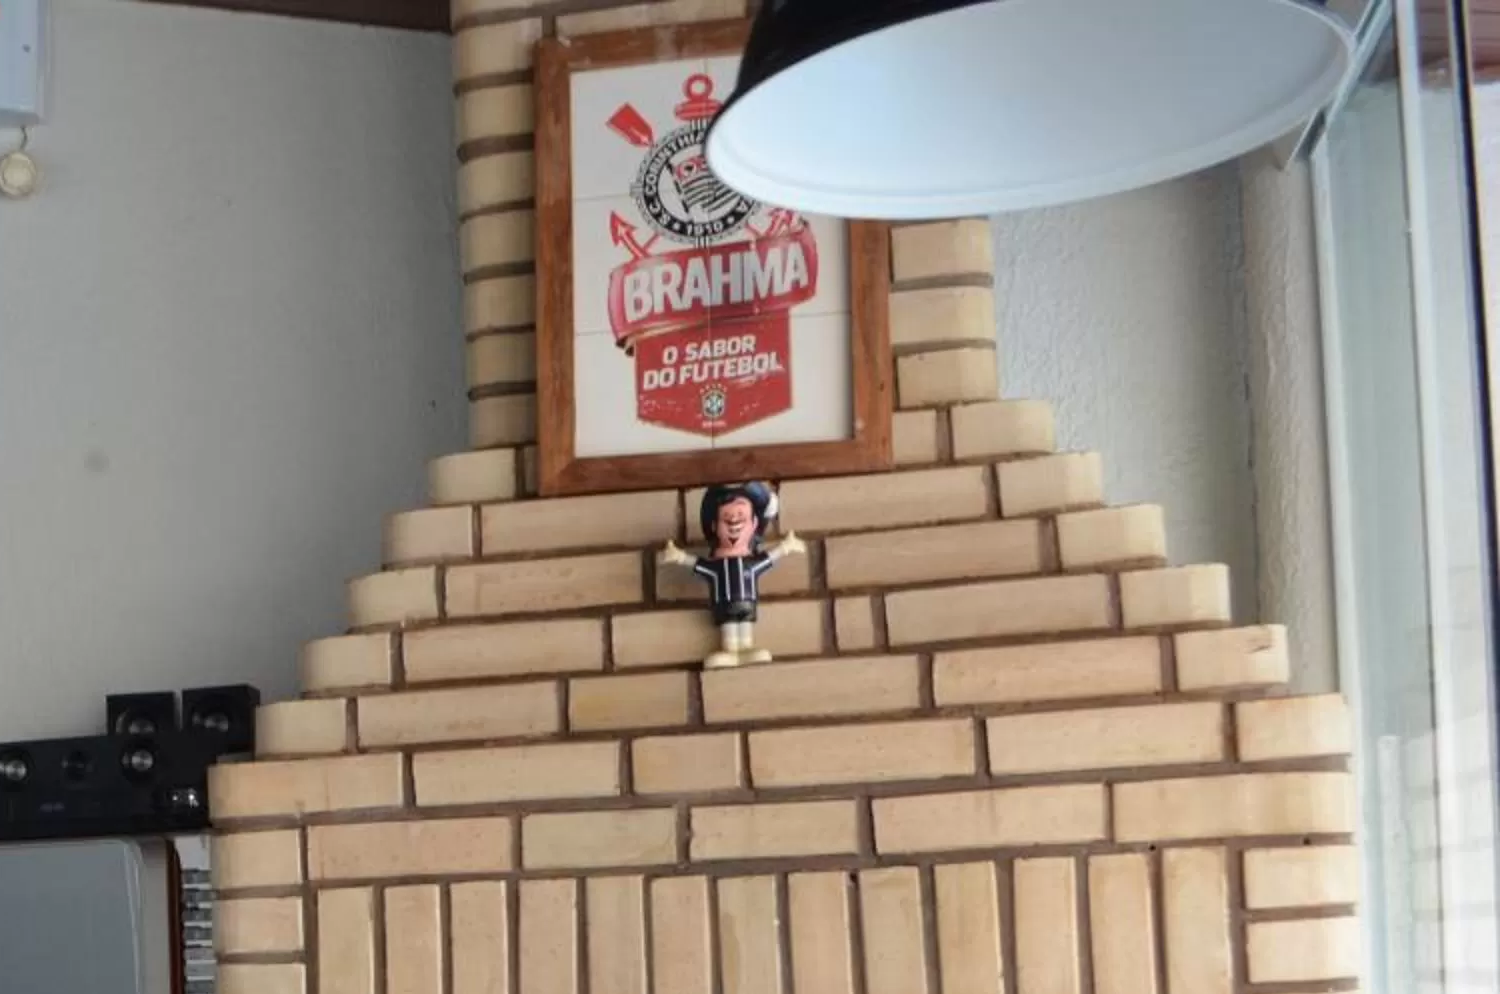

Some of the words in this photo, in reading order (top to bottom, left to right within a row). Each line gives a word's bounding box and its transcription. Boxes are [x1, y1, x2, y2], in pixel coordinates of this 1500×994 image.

[645, 130, 704, 195] CORINTHIA
[687, 220, 724, 236] 1910
[624, 241, 809, 323] BRAHMA
[662, 346, 678, 365] O
[684, 334, 756, 362] SABOR
[643, 367, 675, 391] DO
[679, 352, 785, 385] FUTEBOL
